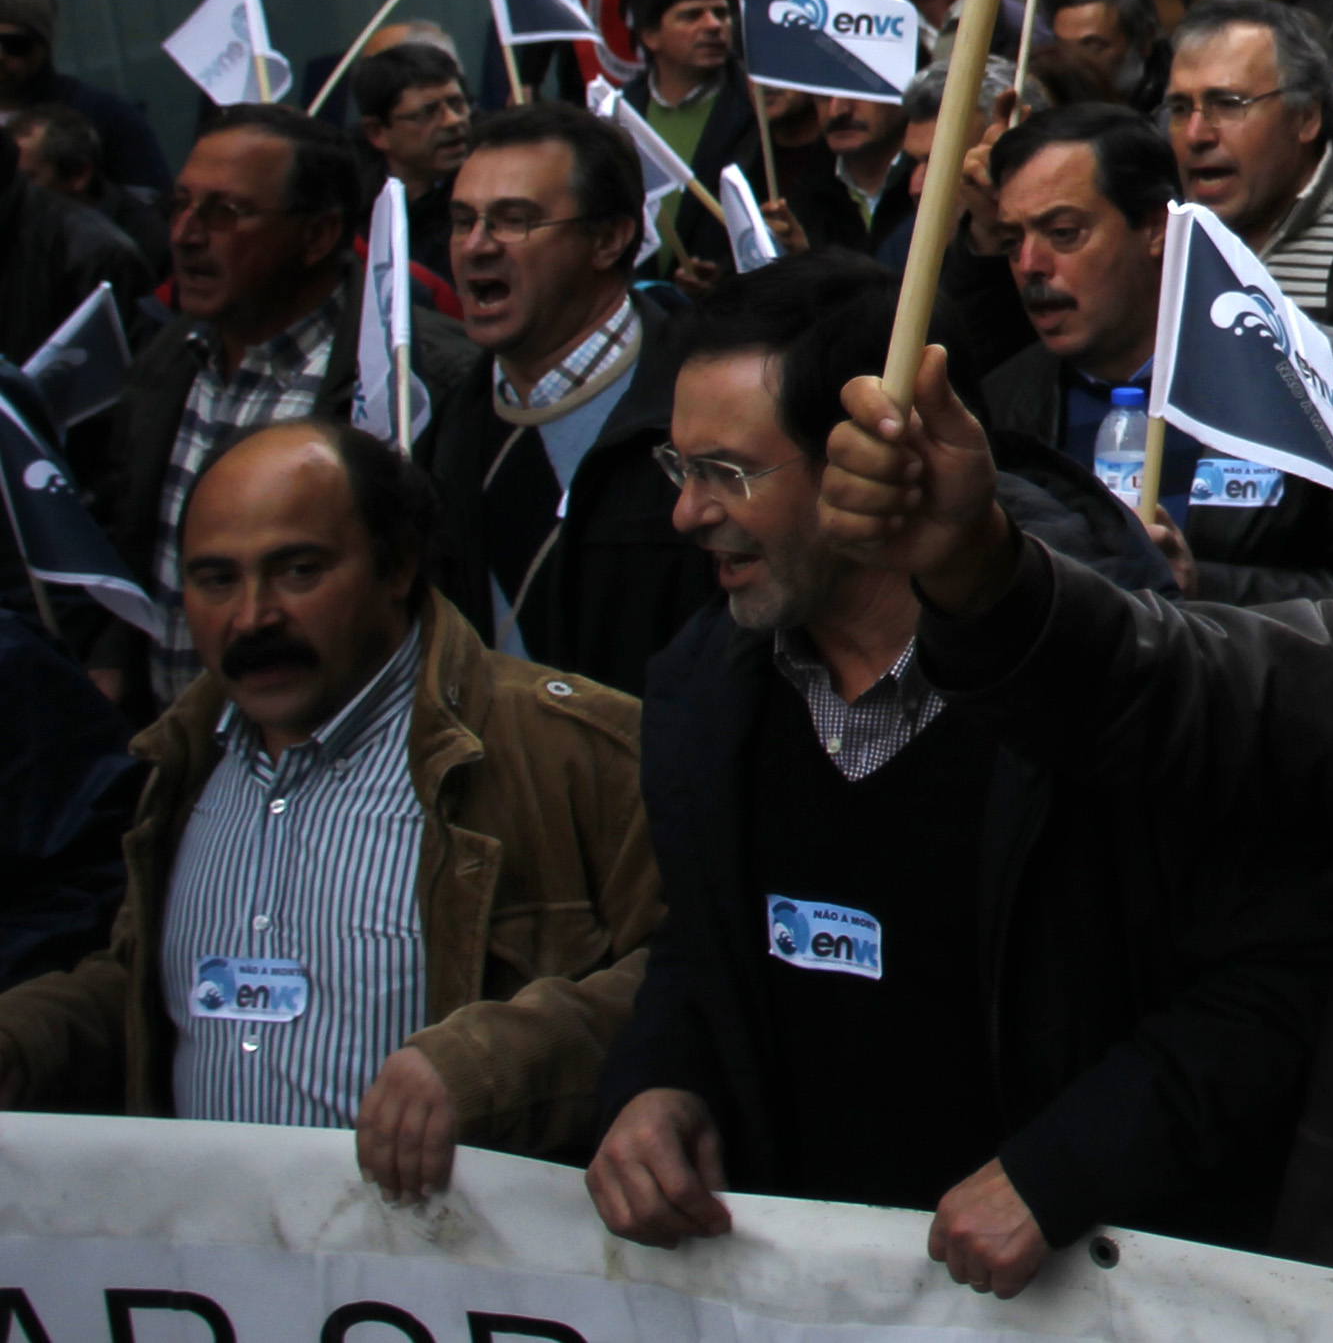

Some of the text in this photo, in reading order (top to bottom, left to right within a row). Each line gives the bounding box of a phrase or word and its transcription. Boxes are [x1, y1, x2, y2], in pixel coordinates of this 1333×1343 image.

[833, 11, 904, 37] envc
[851, 916, 878, 932] MORT
[811, 931, 879, 969] envc
[236, 983, 302, 1010] envc
